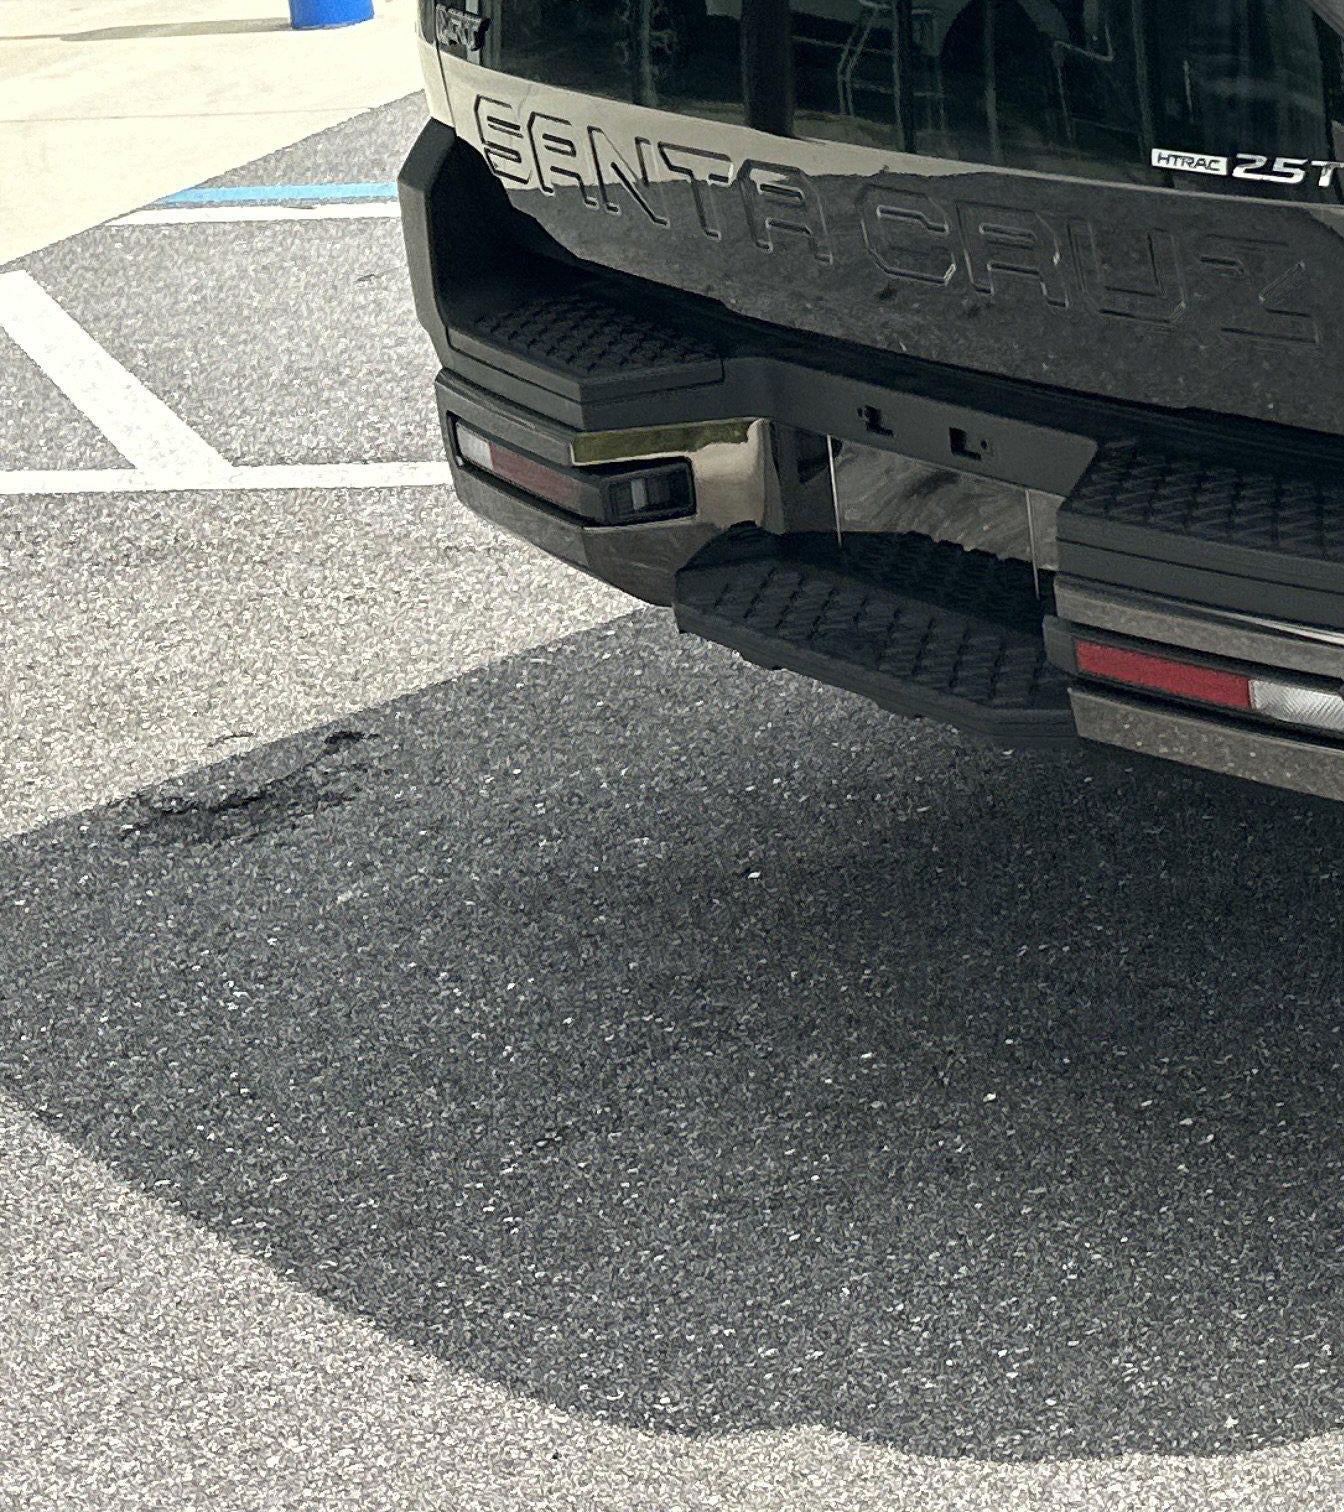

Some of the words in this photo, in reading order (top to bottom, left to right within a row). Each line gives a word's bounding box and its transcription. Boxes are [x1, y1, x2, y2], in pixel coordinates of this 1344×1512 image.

[474, 93, 833, 265] SANTA
[860, 184, 1320, 344] CRUZ
[1156, 151, 1223, 172] HTRAC
